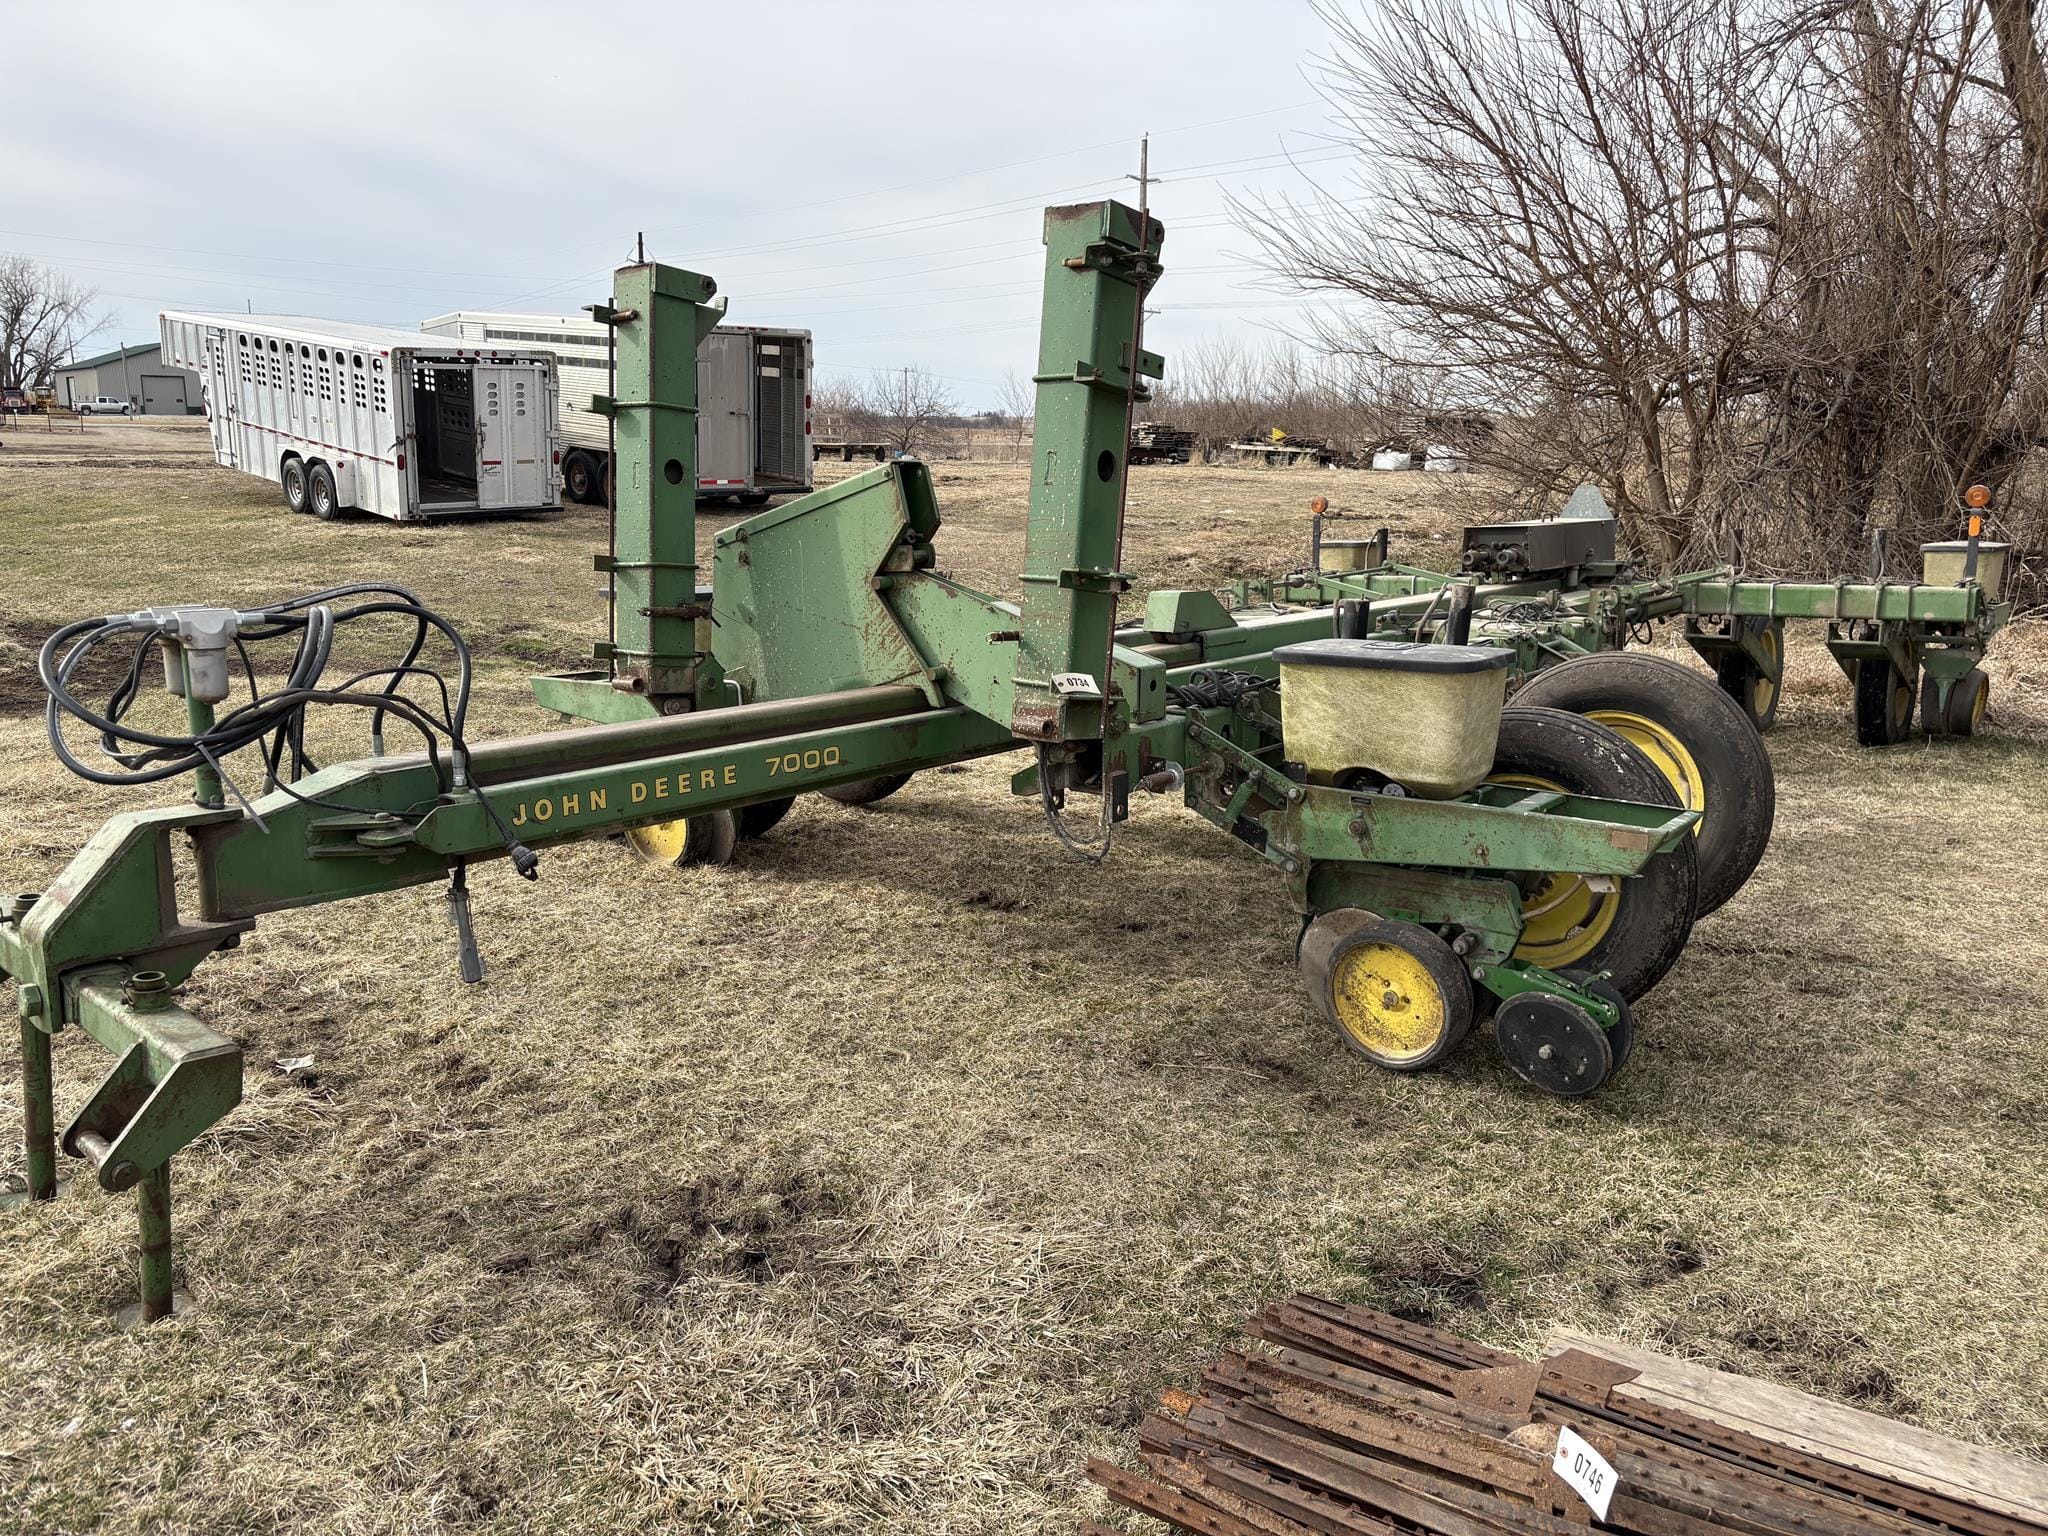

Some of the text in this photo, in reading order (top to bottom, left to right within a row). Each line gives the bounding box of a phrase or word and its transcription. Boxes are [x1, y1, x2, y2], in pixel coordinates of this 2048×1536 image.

[1066, 677, 1090, 687] 0734
[511, 746, 841, 826] JOHN DEERE 7000
[1574, 1452, 1604, 1495] 0746
